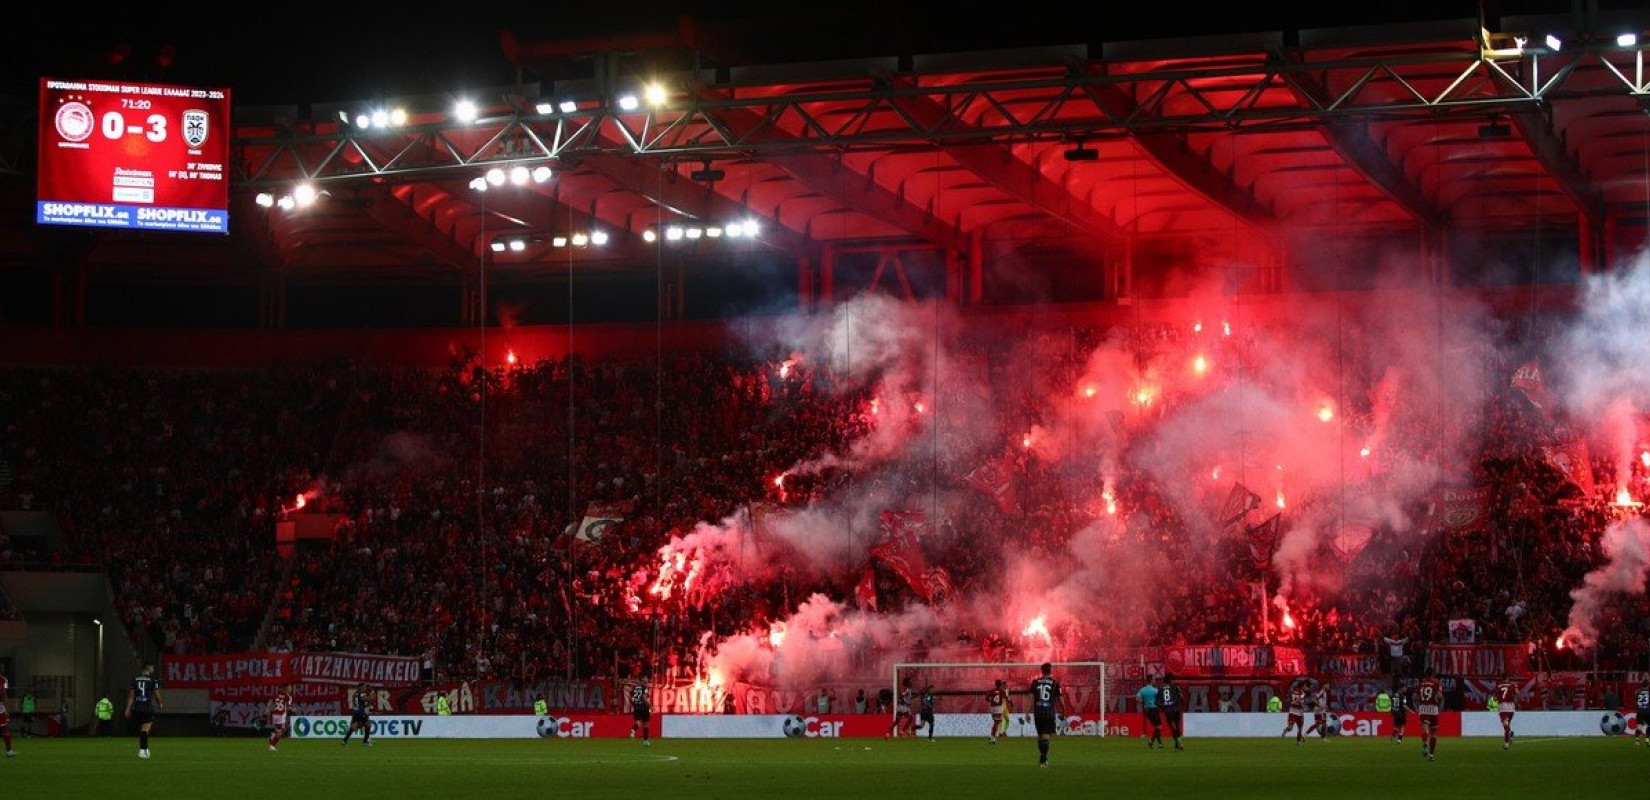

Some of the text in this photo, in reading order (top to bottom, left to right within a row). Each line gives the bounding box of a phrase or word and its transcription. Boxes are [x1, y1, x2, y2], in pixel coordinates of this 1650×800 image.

[141, 87, 162, 95] LEAGUE
[191, 90, 224, 98] 2023-2024
[121, 99, 151, 109] 71:20
[167, 658, 282, 681] KALLIPOLI
[138, 681, 146, 696] 4
[633, 690, 643, 701] 27
[1037, 684, 1051, 701] 16
[1163, 688, 1170, 701] 8
[1420, 686, 1433, 702] 19
[1500, 686, 1508, 699] 7
[1637, 693, 1650, 706] 23
[313, 719, 422, 736] COSOTE TV
[557, 717, 594, 738] Car
[804, 716, 844, 738] Car
[1340, 714, 1384, 737] Car
